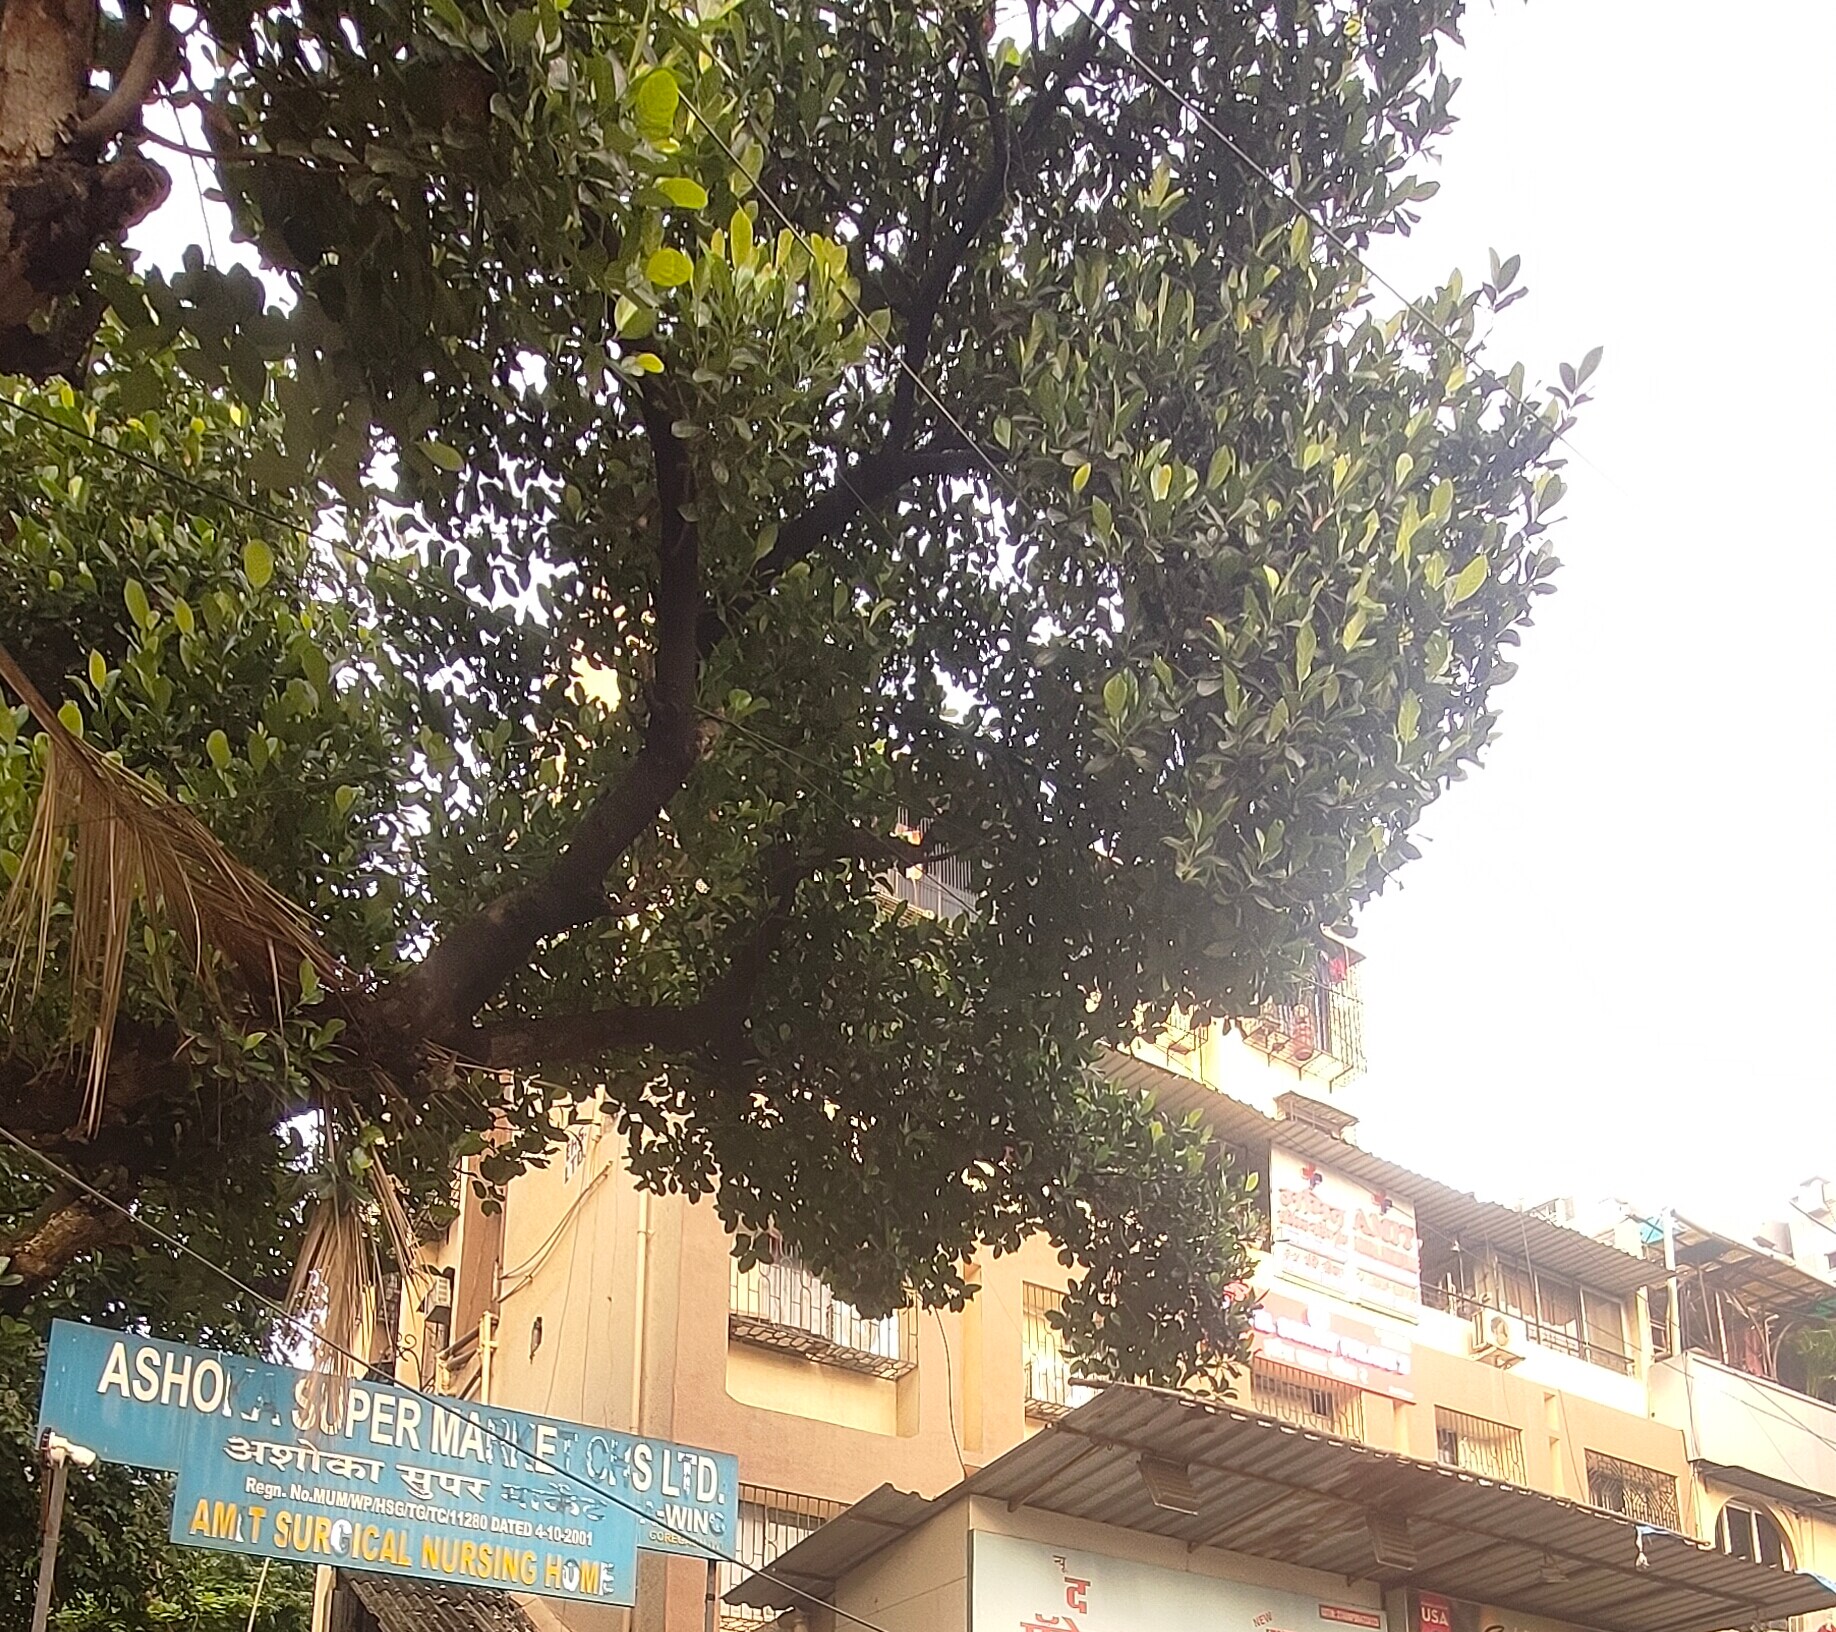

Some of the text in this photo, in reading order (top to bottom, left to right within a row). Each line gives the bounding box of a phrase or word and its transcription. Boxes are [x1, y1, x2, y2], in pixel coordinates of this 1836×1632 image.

[223, 1435, 386, 1484] अशोका
[395, 1464, 492, 1502] सुपर
[292, 1375, 423, 1452] SUPER
[661, 1449, 726, 1505] LTD.
[245, 1476, 287, 1500] Regn.
[491, 1516, 533, 1537] DATED
[535, 1523, 593, 1547] 4-10-2001
[188, 1498, 616, 1597] AMIT SURGICAL NURSING HOME
[1064, 1576, 1091, 1614] द
[1252, 1611, 1274, 1628] NEW
[1421, 1606, 1449, 1627] USA
